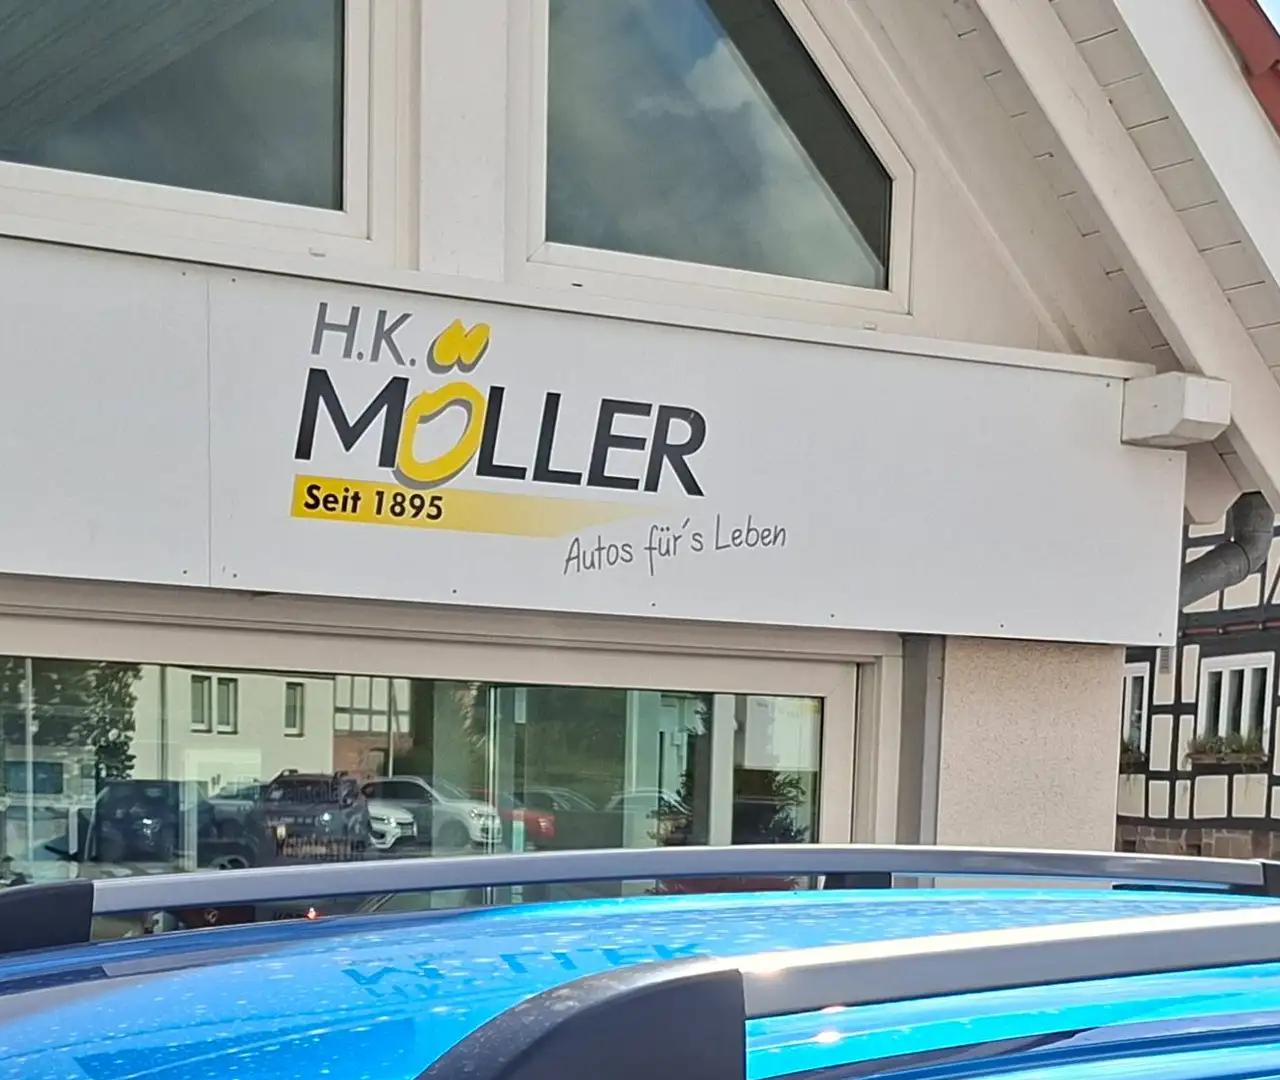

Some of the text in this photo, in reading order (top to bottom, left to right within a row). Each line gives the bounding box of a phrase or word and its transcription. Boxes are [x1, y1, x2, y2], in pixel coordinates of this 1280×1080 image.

[311, 302, 417, 367] H.K.
[294, 319, 706, 496] MÖLLER
[304, 484, 443, 520] Seit 1895
[564, 535, 633, 575] Autos
[715, 514, 786, 550] Leben
